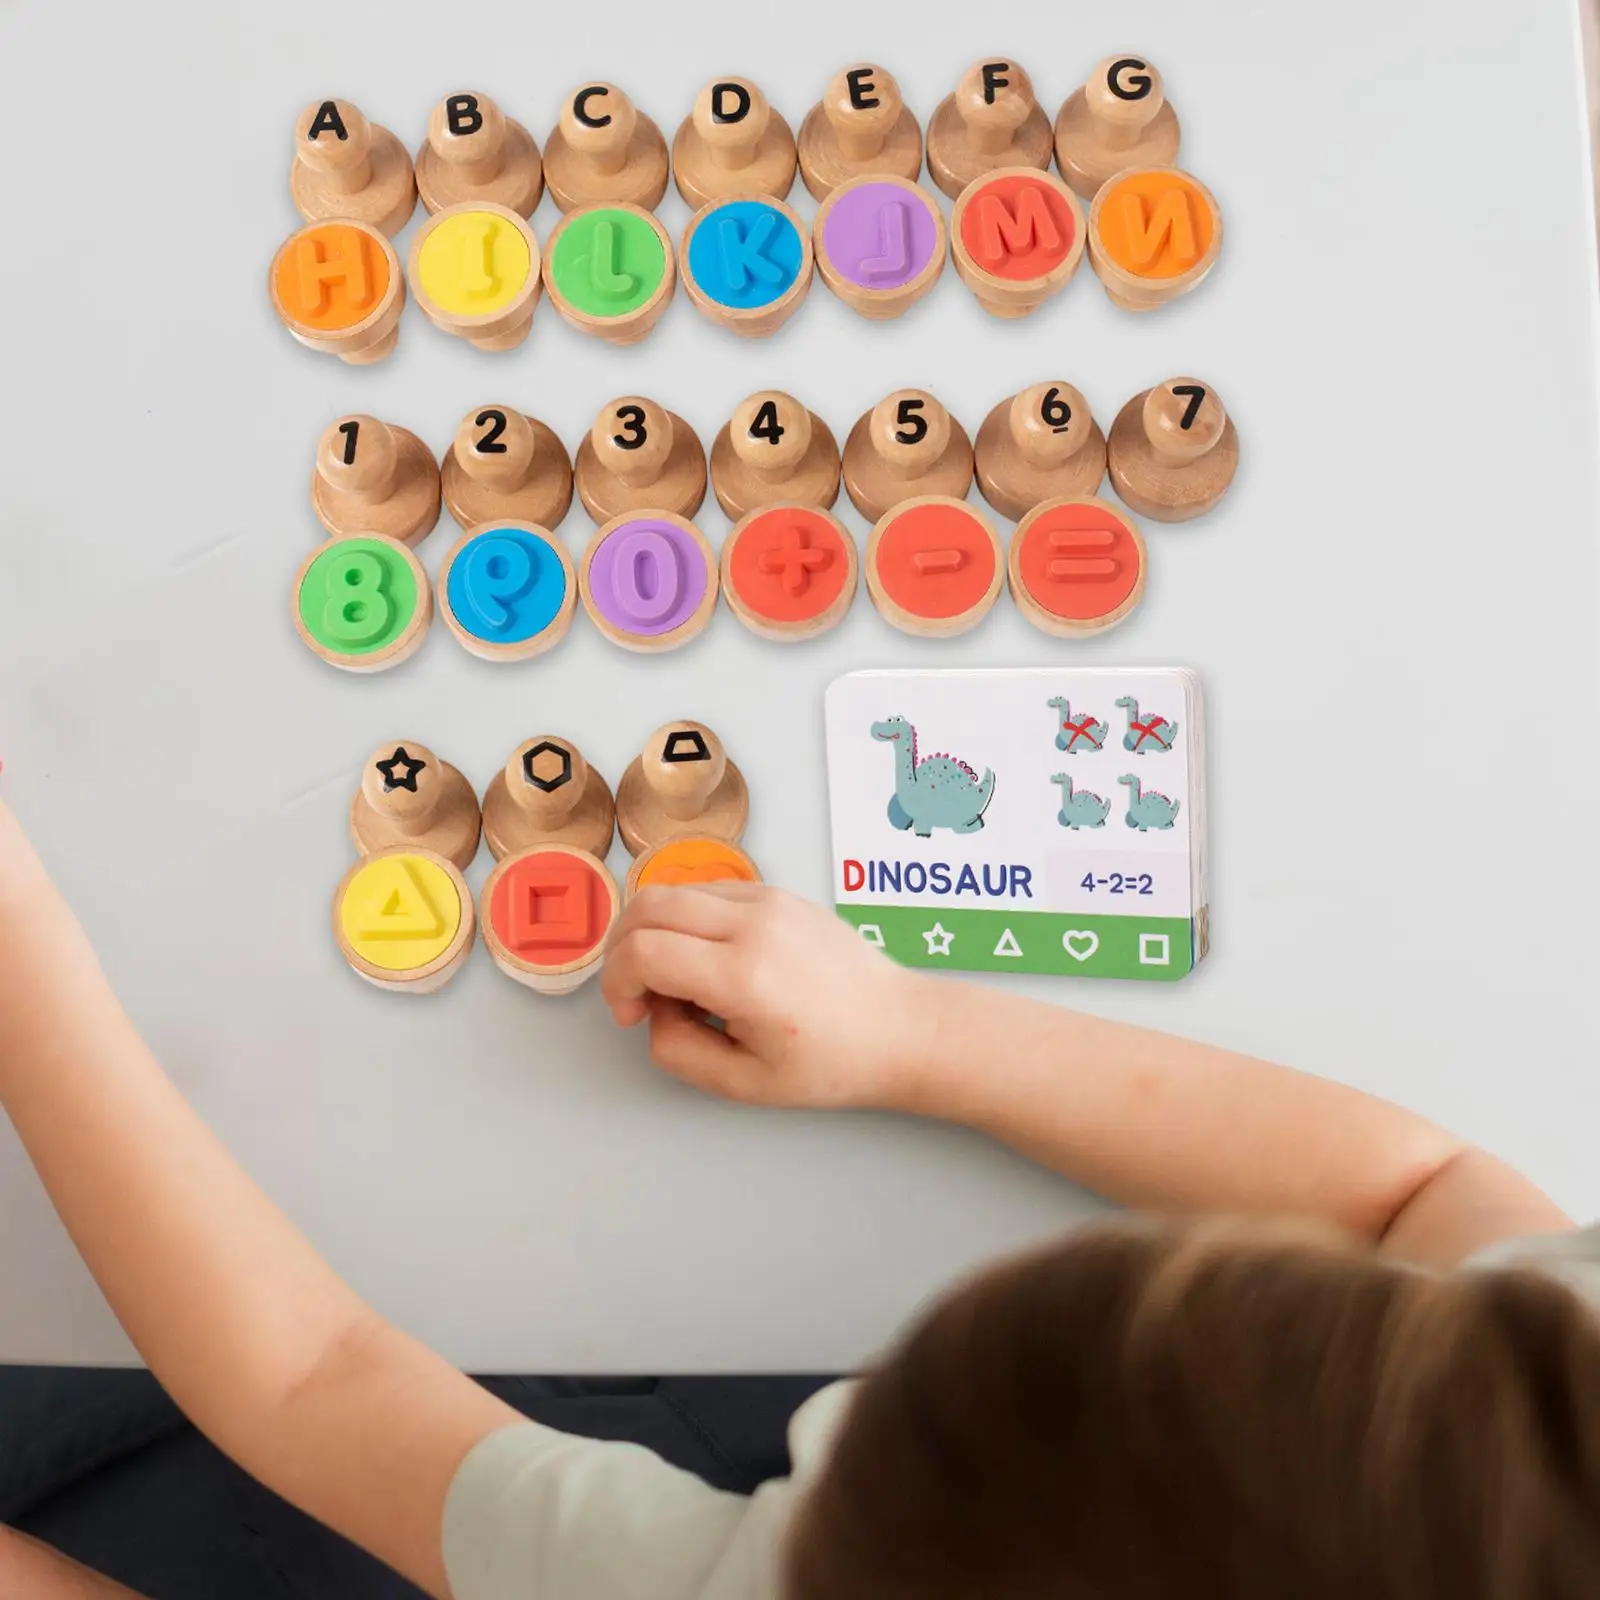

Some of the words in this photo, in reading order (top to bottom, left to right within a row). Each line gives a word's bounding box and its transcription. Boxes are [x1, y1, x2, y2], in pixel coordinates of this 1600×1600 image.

[846, 68, 880, 110] E
[982, 62, 1010, 105] F
[1107, 58, 1152, 101] G
[307, 101, 348, 141] A
[446, 94, 483, 136] B
[573, 86, 611, 128] C
[711, 82, 751, 124] D
[613, 404, 648, 450] 3
[748, 400, 785, 445] 4
[895, 399, 928, 445] 5
[1040, 387, 1072, 434] 6
[1171, 385, 1206, 430] 7
[338, 420, 360, 465] 1
[475, 410, 507, 453] 2
[843, 859, 1033, 898] DINOSAUR
[1080, 872, 1153, 895] 4-2=2
